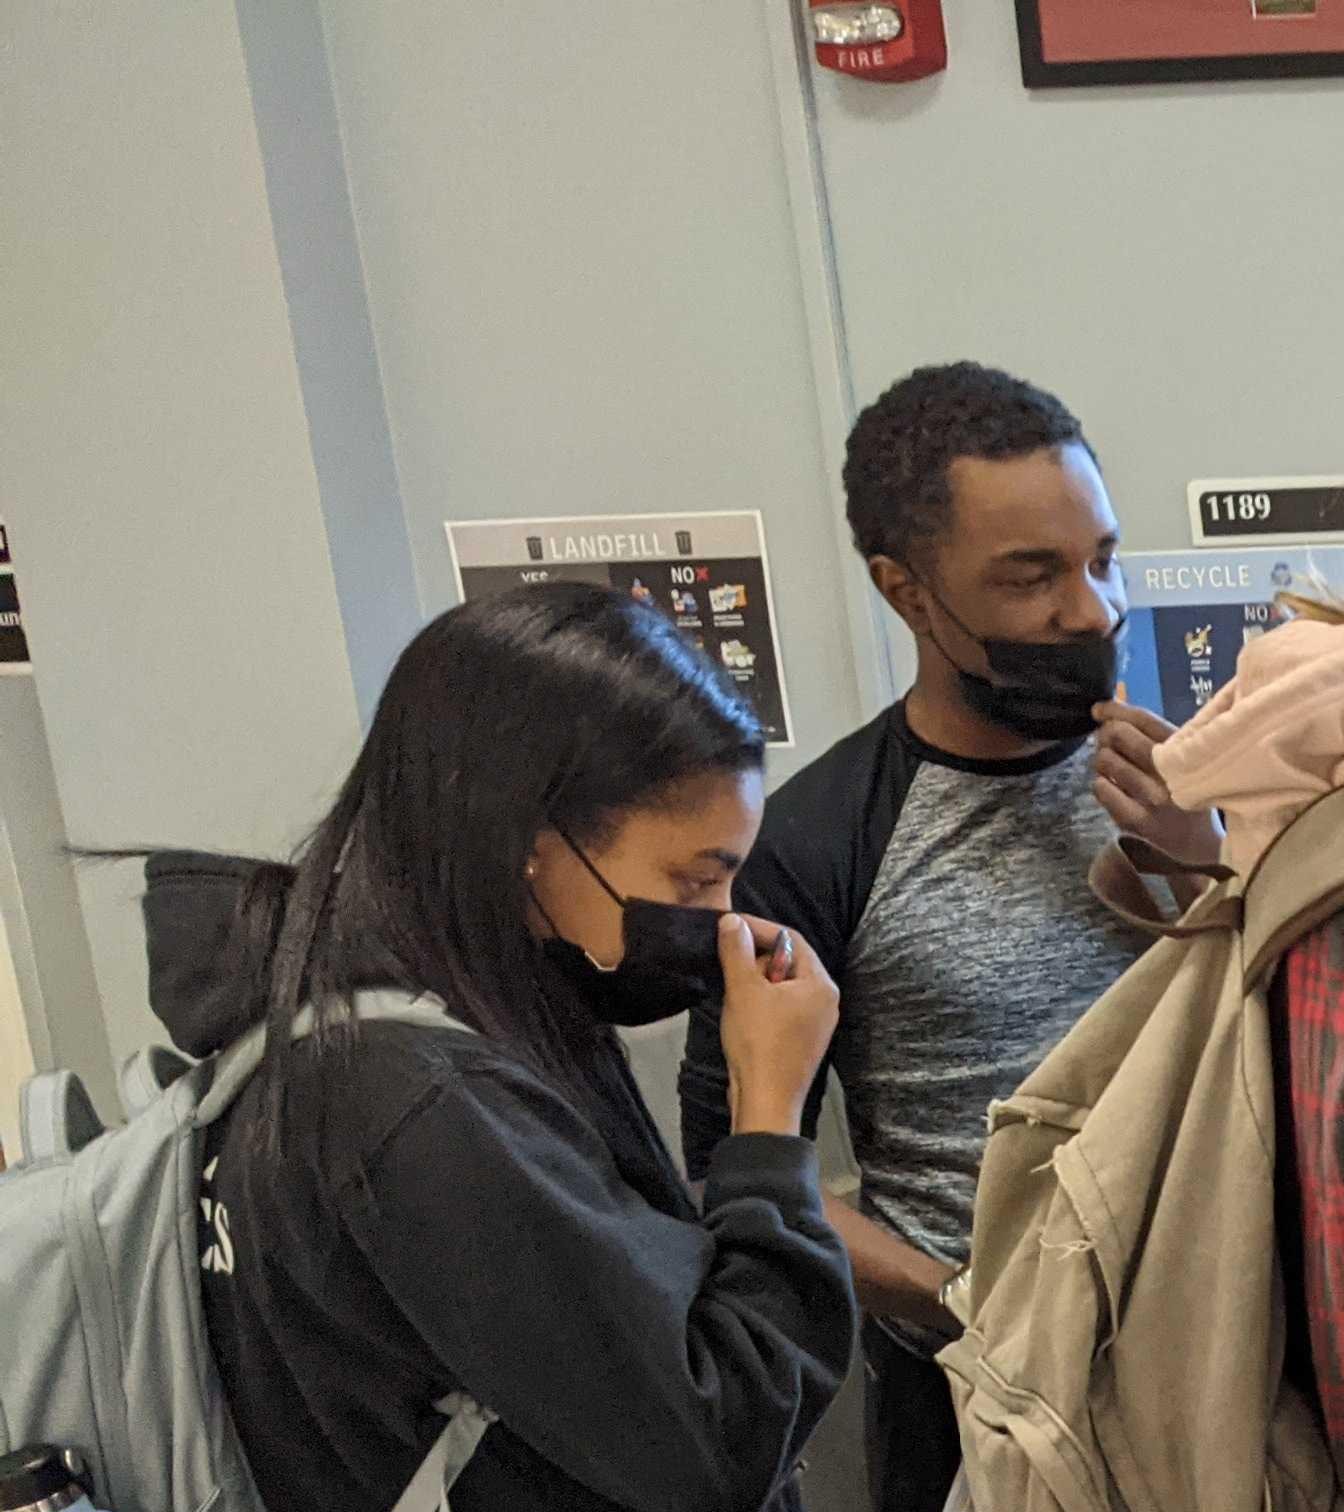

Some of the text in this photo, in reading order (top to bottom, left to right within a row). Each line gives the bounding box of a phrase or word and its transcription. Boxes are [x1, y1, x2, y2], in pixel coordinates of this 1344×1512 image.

[837, 48, 884, 67] FIRE
[1206, 493, 1271, 520] 1189
[549, 533, 666, 560] LANDFILL
[671, 566, 695, 584] NO
[1145, 564, 1250, 590] RECYCLE
[1245, 605, 1268, 621] NO
